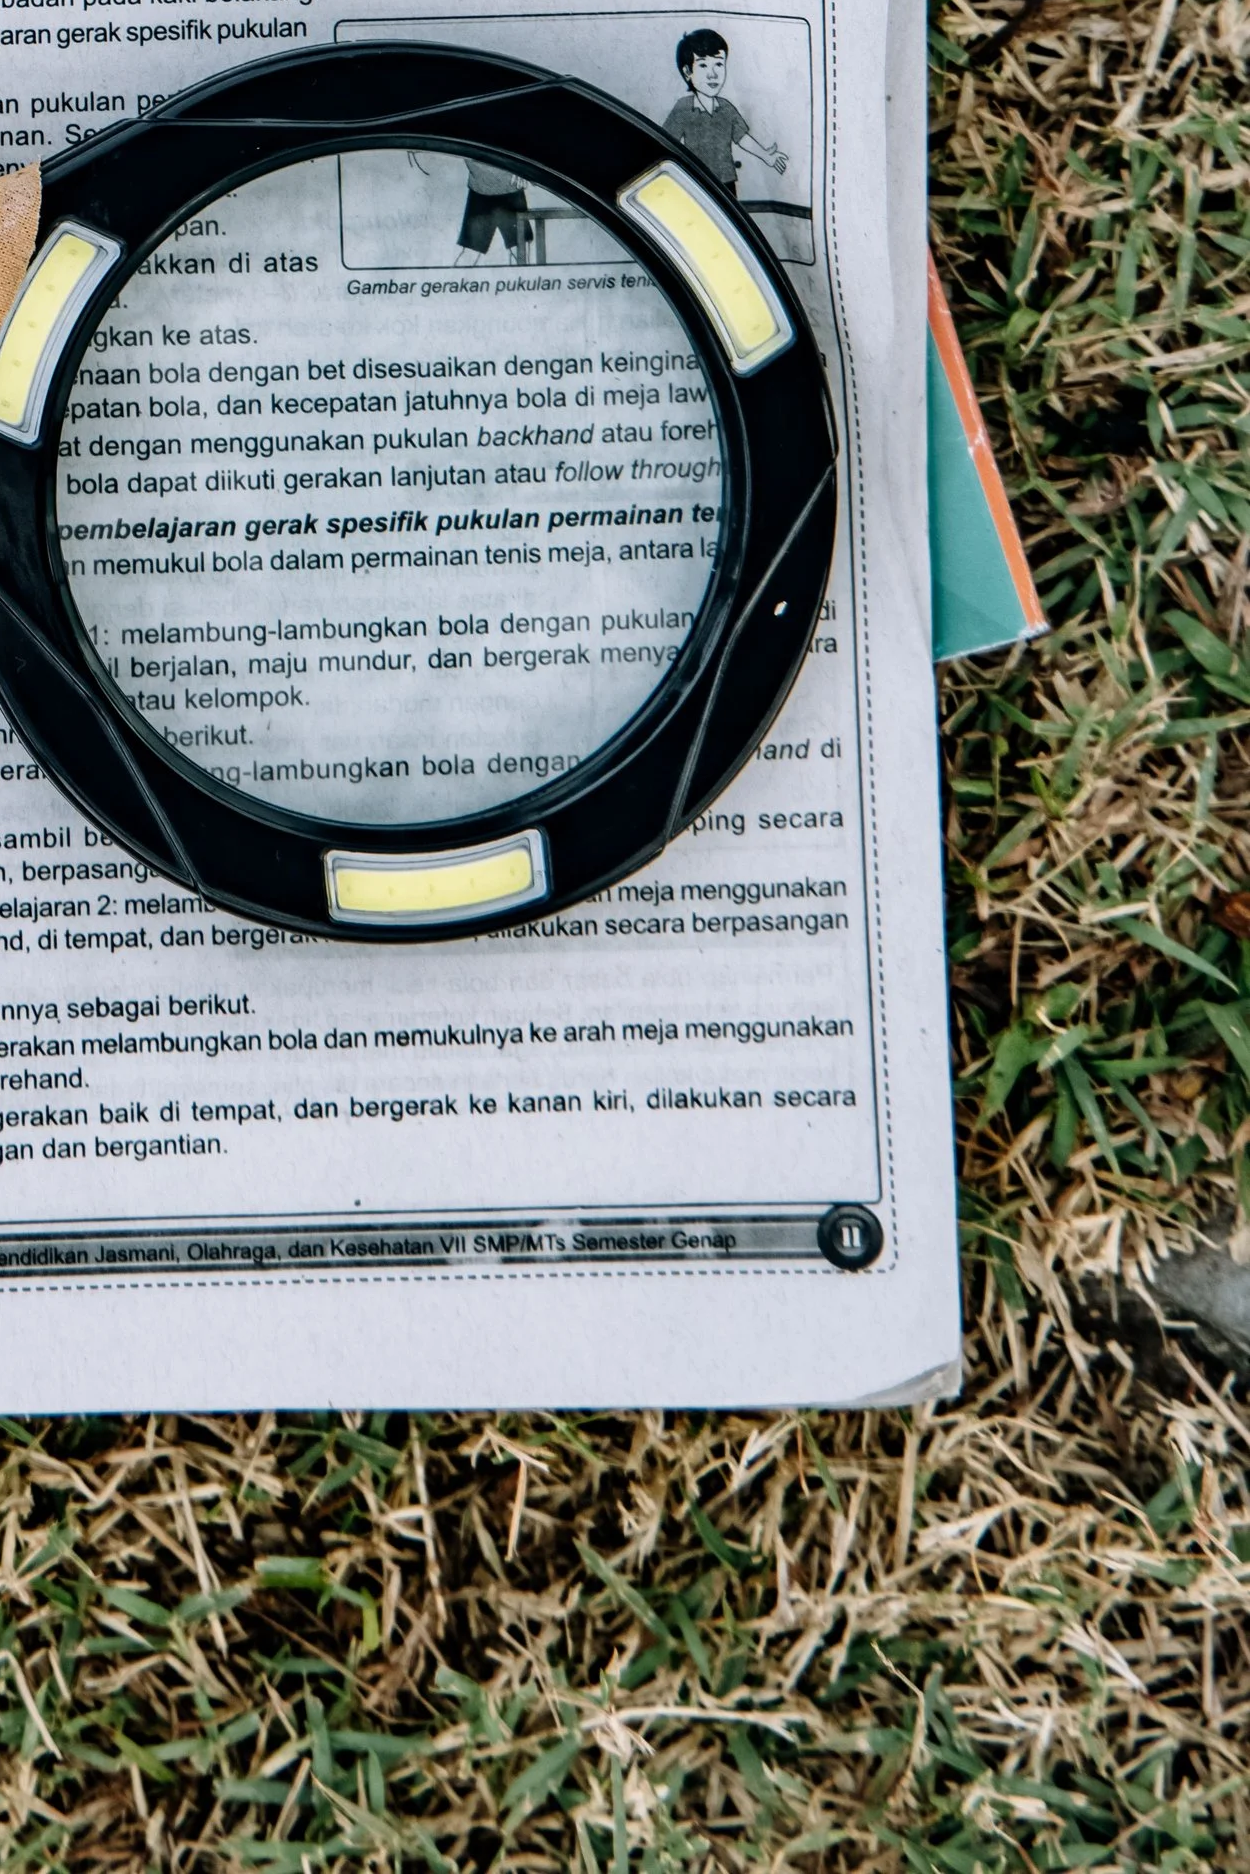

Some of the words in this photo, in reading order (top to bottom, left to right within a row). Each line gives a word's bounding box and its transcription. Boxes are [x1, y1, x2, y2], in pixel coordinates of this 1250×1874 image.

[346, 278, 418, 296] Gambar
[420, 277, 490, 298] gerakan
[494, 276, 562, 296] pukulan
[566, 276, 616, 291] servis
[161, 323, 191, 346] ke
[199, 324, 258, 346] atas.
[149, 395, 208, 419] bola,
[216, 394, 262, 416] dan
[271, 392, 397, 419] kecepatan
[403, 389, 508, 417] jatuhnya
[516, 386, 567, 409] bola
[574, 385, 595, 407] di
[603, 388, 660, 411] meja
[88, 434, 182, 462] dengan
[190, 429, 365, 459] menggunakan
[373, 426, 469, 455] pukulan
[476, 422, 595, 448] backhand
[601, 422, 653, 444] atau
[93, 551, 206, 576] memukul
[212, 550, 264, 573] bola
[269, 548, 344, 571] dalam
[351, 549, 479, 575] permainan
[484, 545, 542, 565] tenis
[548, 545, 612, 568] meja,
[618, 539, 694, 561] antara
[130, 654, 237, 683] berjalan,
[248, 651, 308, 679] maju
[318, 649, 417, 673] mundur,
[427, 647, 473, 670] dan
[483, 643, 591, 672] bergerak
[66, 994, 160, 1023] sebagai
[168, 993, 256, 1017] berikut.
[81, 1030, 262, 1058] melambungkan
[268, 1027, 318, 1051] bola
[323, 1027, 368, 1050] dan
[373, 1023, 524, 1051] memukulnya
[529, 1021, 558, 1044] ke
[563, 1019, 616, 1043] arah
[622, 1022, 679, 1046] meja
[685, 1014, 854, 1044] menggunakan
[99, 1101, 150, 1125] baik
[159, 1099, 180, 1123] di
[190, 1099, 282, 1126] tempat,
[293, 1097, 339, 1120] dan
[349, 1093, 459, 1123] bergerak
[469, 1093, 498, 1115] ke
[507, 1091, 582, 1114] kanan
[593, 1088, 635, 1114] kiri,
[645, 1086, 763, 1111] dilakukan
[773, 1089, 857, 1108] secara
[41, 1137, 87, 1160] dan
[94, 1134, 229, 1162] bergantian.
[94, 1242, 181, 1264] Jasmani,
[187, 1240, 282, 1264] Olahraga,
[288, 1239, 324, 1259] dan
[331, 1236, 434, 1257] Kesehatan
[440, 1235, 466, 1254] VII
[473, 1233, 566, 1255] SMP/MTs
[573, 1231, 665, 1252] Semester
[671, 1230, 737, 1255] Genap
